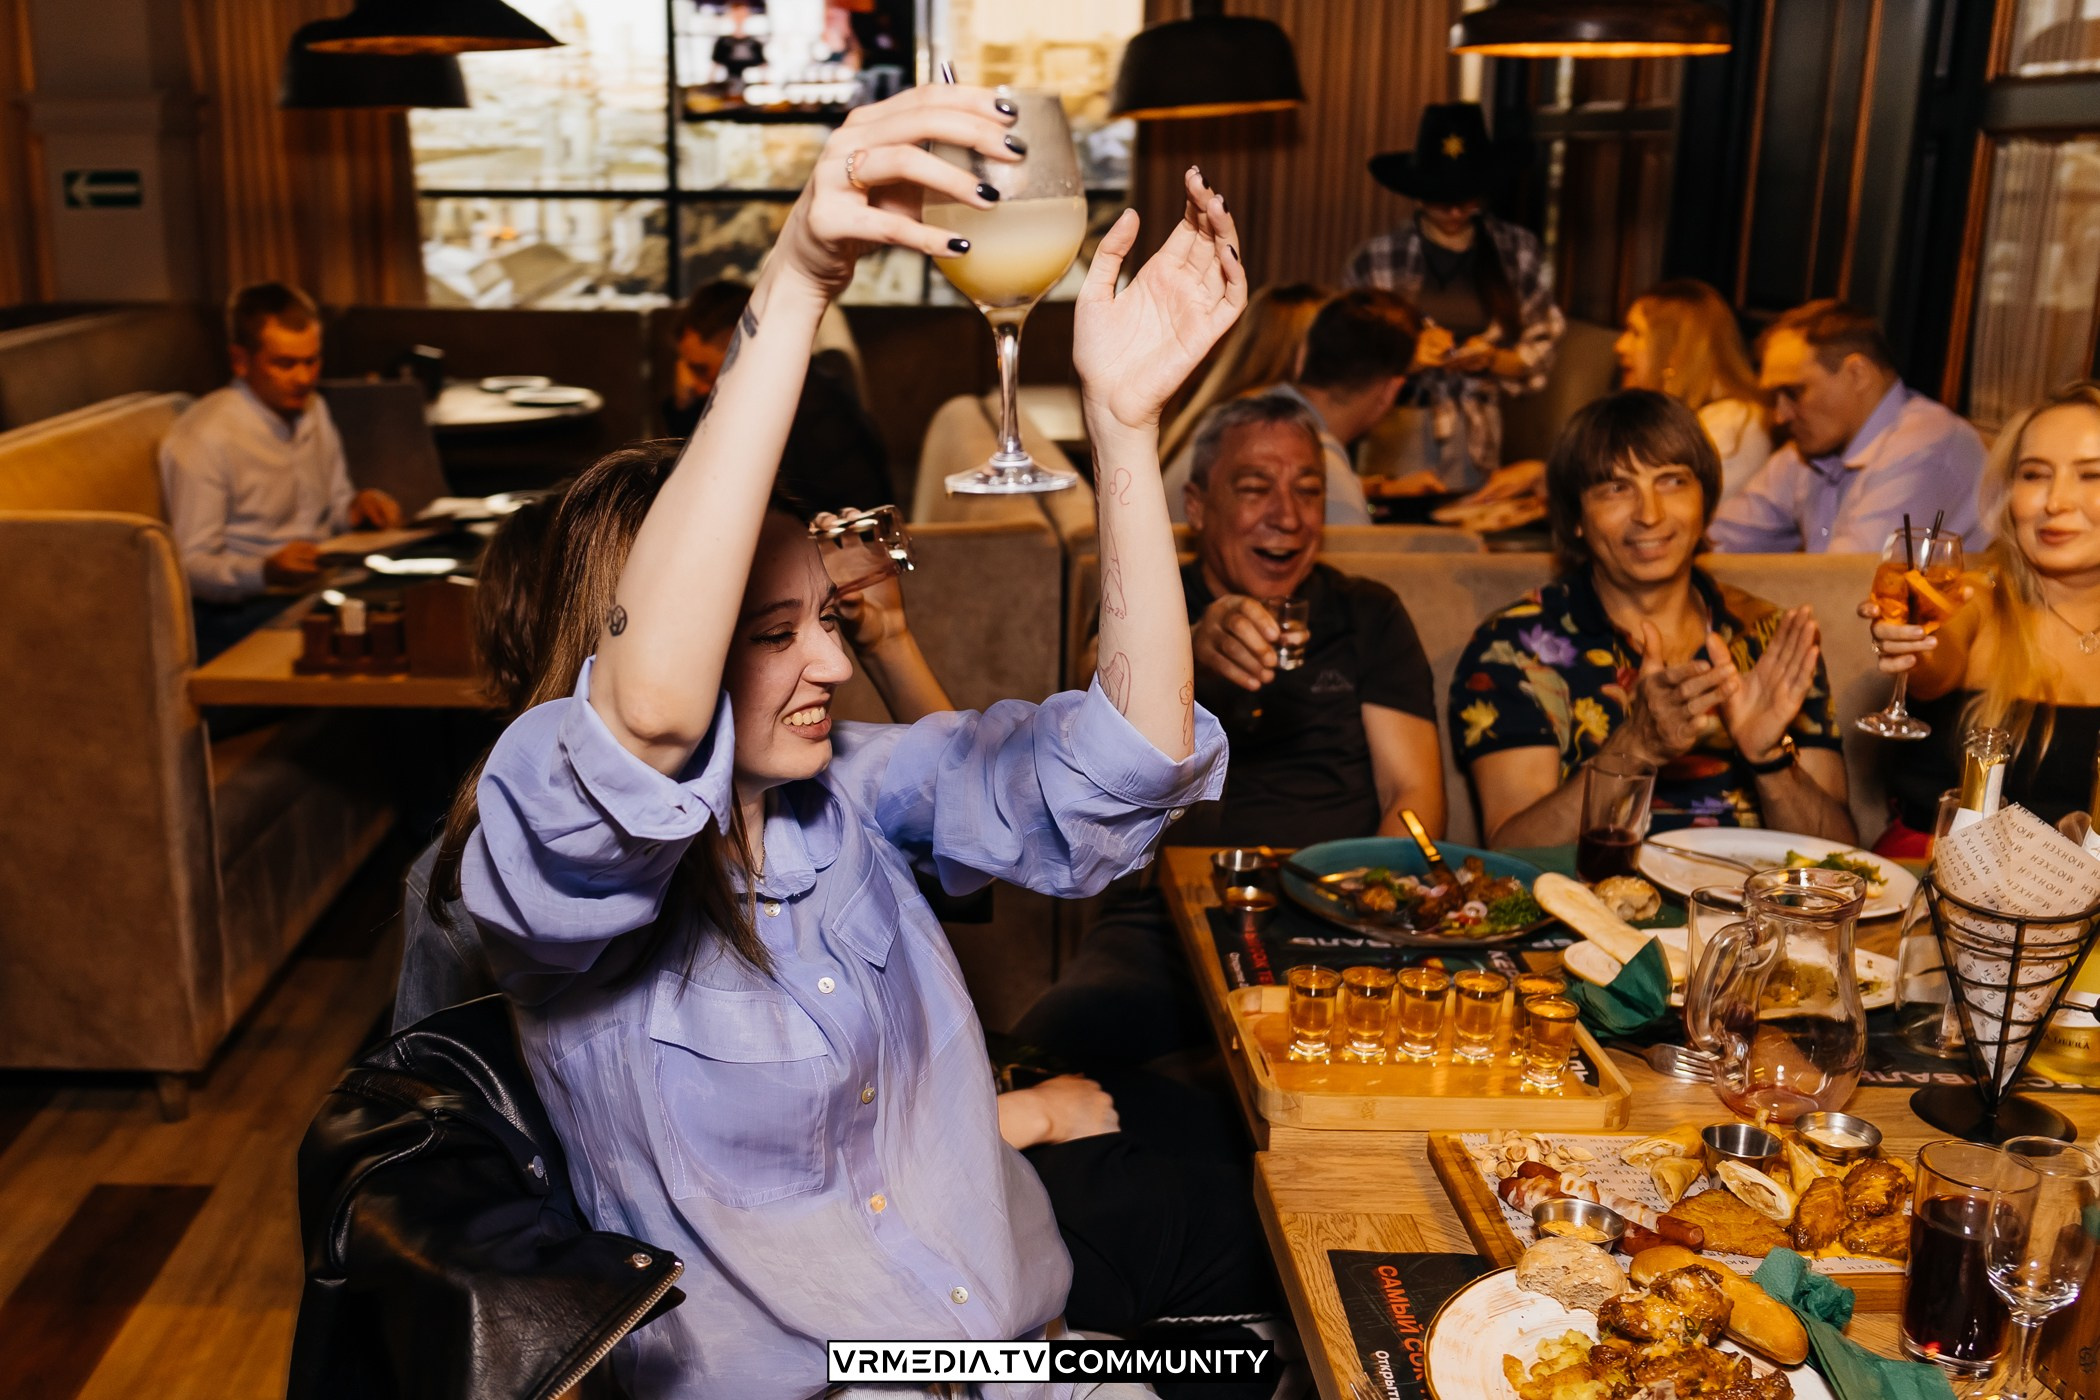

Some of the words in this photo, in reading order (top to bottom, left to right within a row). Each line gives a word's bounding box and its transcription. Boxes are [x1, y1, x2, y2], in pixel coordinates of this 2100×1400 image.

[1960, 831, 1993, 876] МЮНХЕ
[2042, 841, 2087, 870] МЮНХЕН
[1377, 1264, 1425, 1335] САМЫЙ
[1374, 1350, 1401, 1400] Открыт
